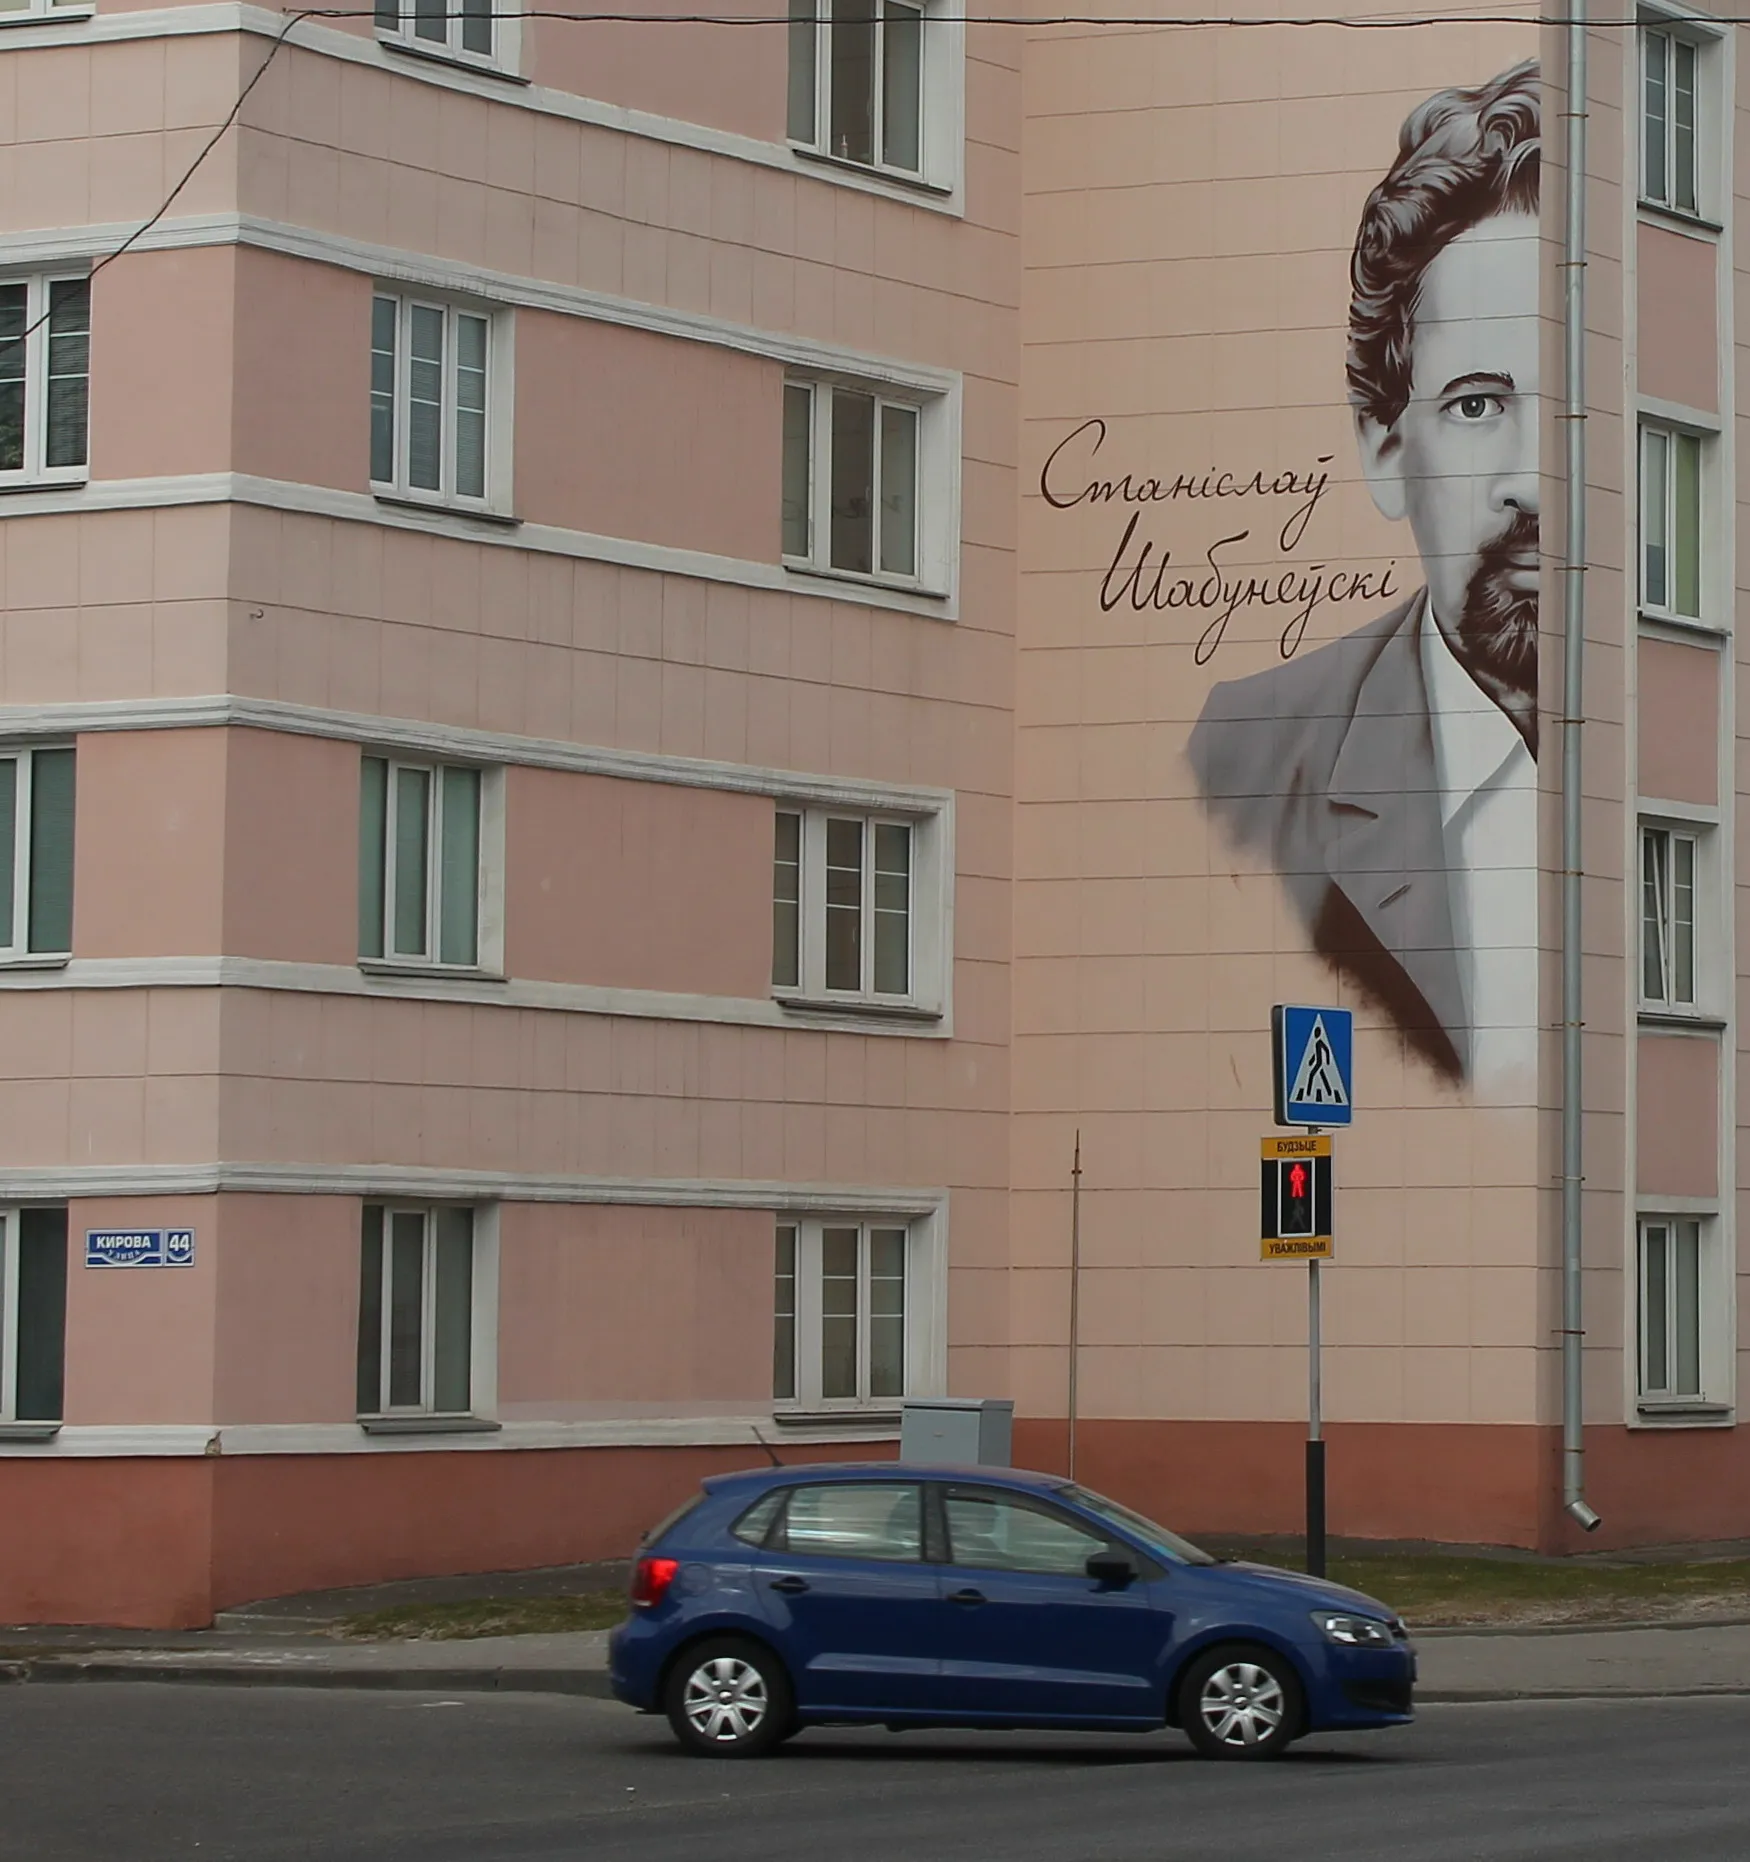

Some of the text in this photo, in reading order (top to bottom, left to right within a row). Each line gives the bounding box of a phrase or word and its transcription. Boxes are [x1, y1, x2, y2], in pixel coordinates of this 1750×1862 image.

[1040, 418, 1336, 552] Станіслаў
[1099, 510, 1399, 666] Шабунеўскі
[96, 1234, 190, 1252] КИРОВА 44
